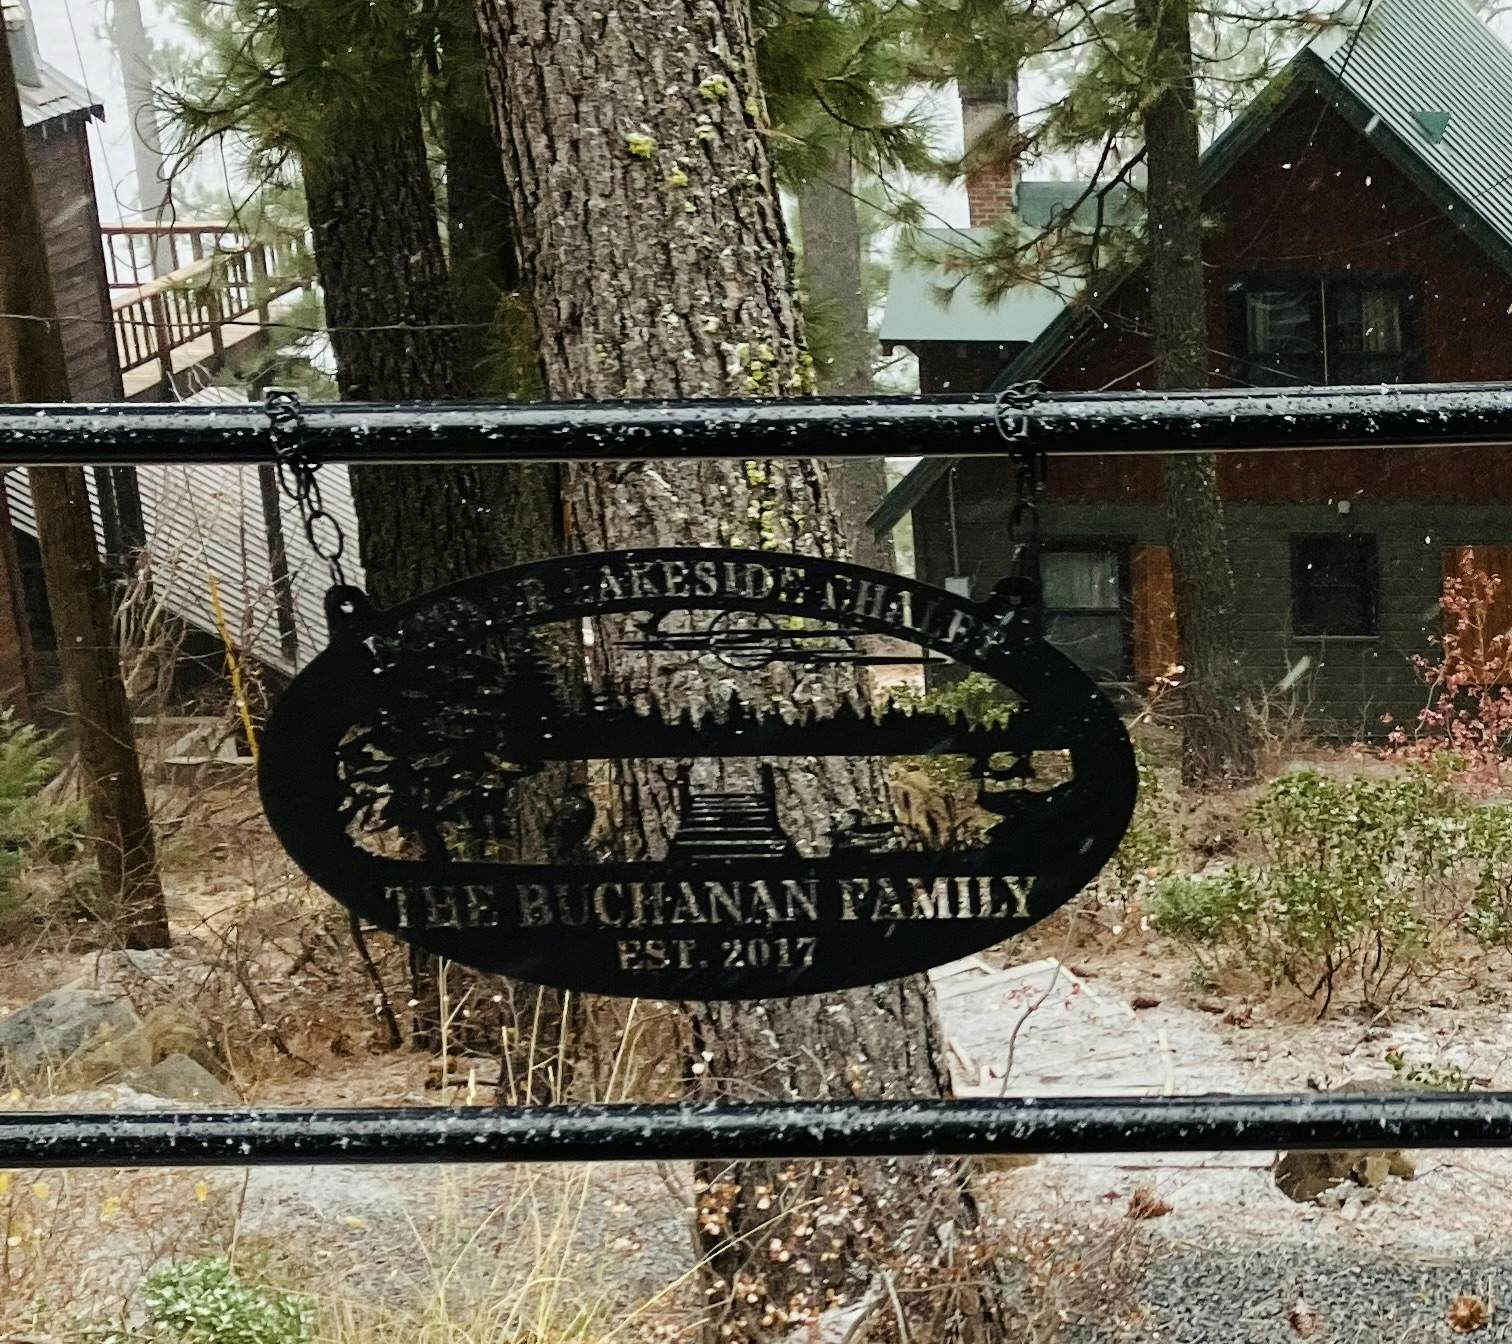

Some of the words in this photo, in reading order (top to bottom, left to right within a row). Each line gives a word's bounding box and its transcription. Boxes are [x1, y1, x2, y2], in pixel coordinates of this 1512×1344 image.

[570, 560, 806, 605] LAKESIDE
[385, 885, 500, 929] THE
[518, 878, 822, 928] BUCHANAN
[839, 874, 1038, 922] FAMILY
[617, 940, 710, 971] EST.
[722, 936, 820, 970] 2017
